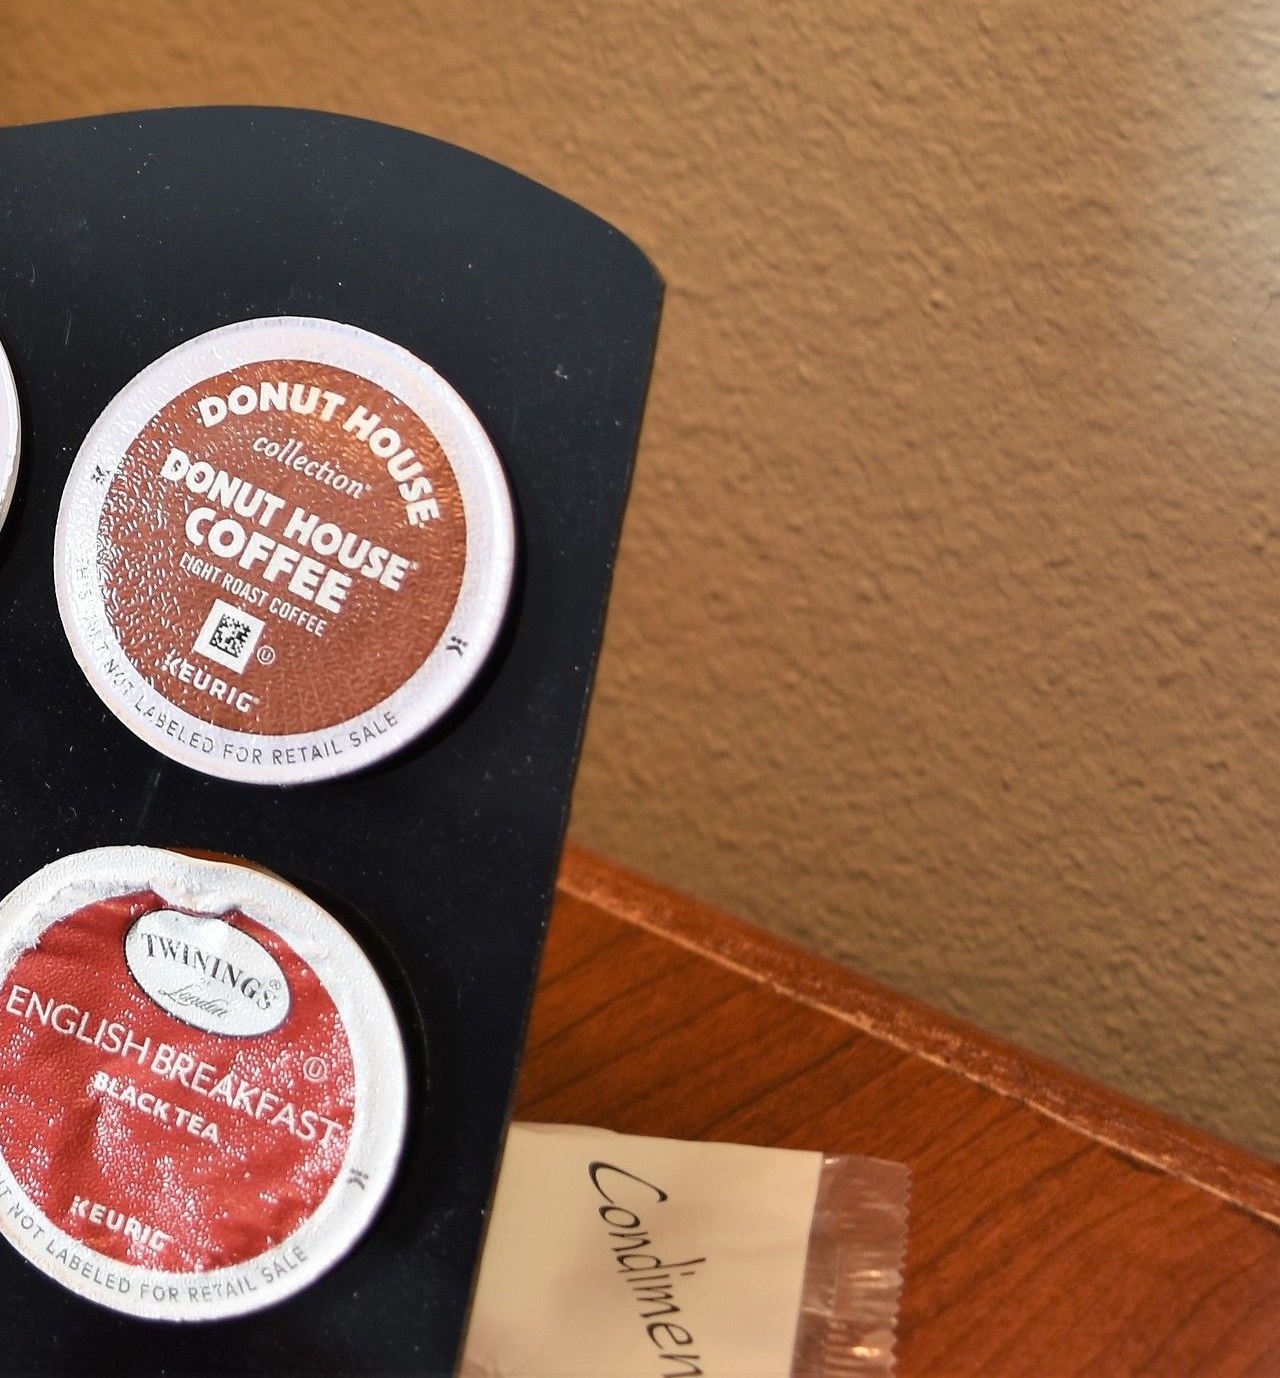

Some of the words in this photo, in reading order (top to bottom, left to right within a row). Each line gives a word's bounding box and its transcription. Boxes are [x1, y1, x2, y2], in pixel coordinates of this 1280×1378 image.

[198, 382, 345, 429] DONUT
[342, 405, 440, 527] HOUSE
[252, 436, 367, 500] collection
[160, 447, 286, 527] DONUT
[282, 507, 411, 592] HOUSE
[185, 506, 353, 615] COFFEE
[179, 552, 222, 584] LIGHT
[221, 571, 269, 607] ROAST
[269, 597, 327, 637] COFFEE
[162, 651, 254, 713] KEURIG
[134, 696, 214, 754] LABELED
[223, 743, 263, 765] FOR
[272, 739, 343, 765] RETAIL
[349, 711, 399, 748] SALE
[141, 932, 277, 1011] TWININGS
[6, 984, 152, 1065] ENGLISH
[151, 1043, 344, 1146] BREAKFAST
[93, 1071, 170, 1123] BLACK
[170, 1107, 220, 1144] TEA
[7, 1202, 45, 1239] NOT
[46, 1238, 131, 1294] LABELED
[139, 1283, 179, 1303] FOR
[188, 1277, 258, 1303] RETAIL
[261, 1245, 309, 1284] SALE
[70, 1194, 175, 1252] KEURIG
